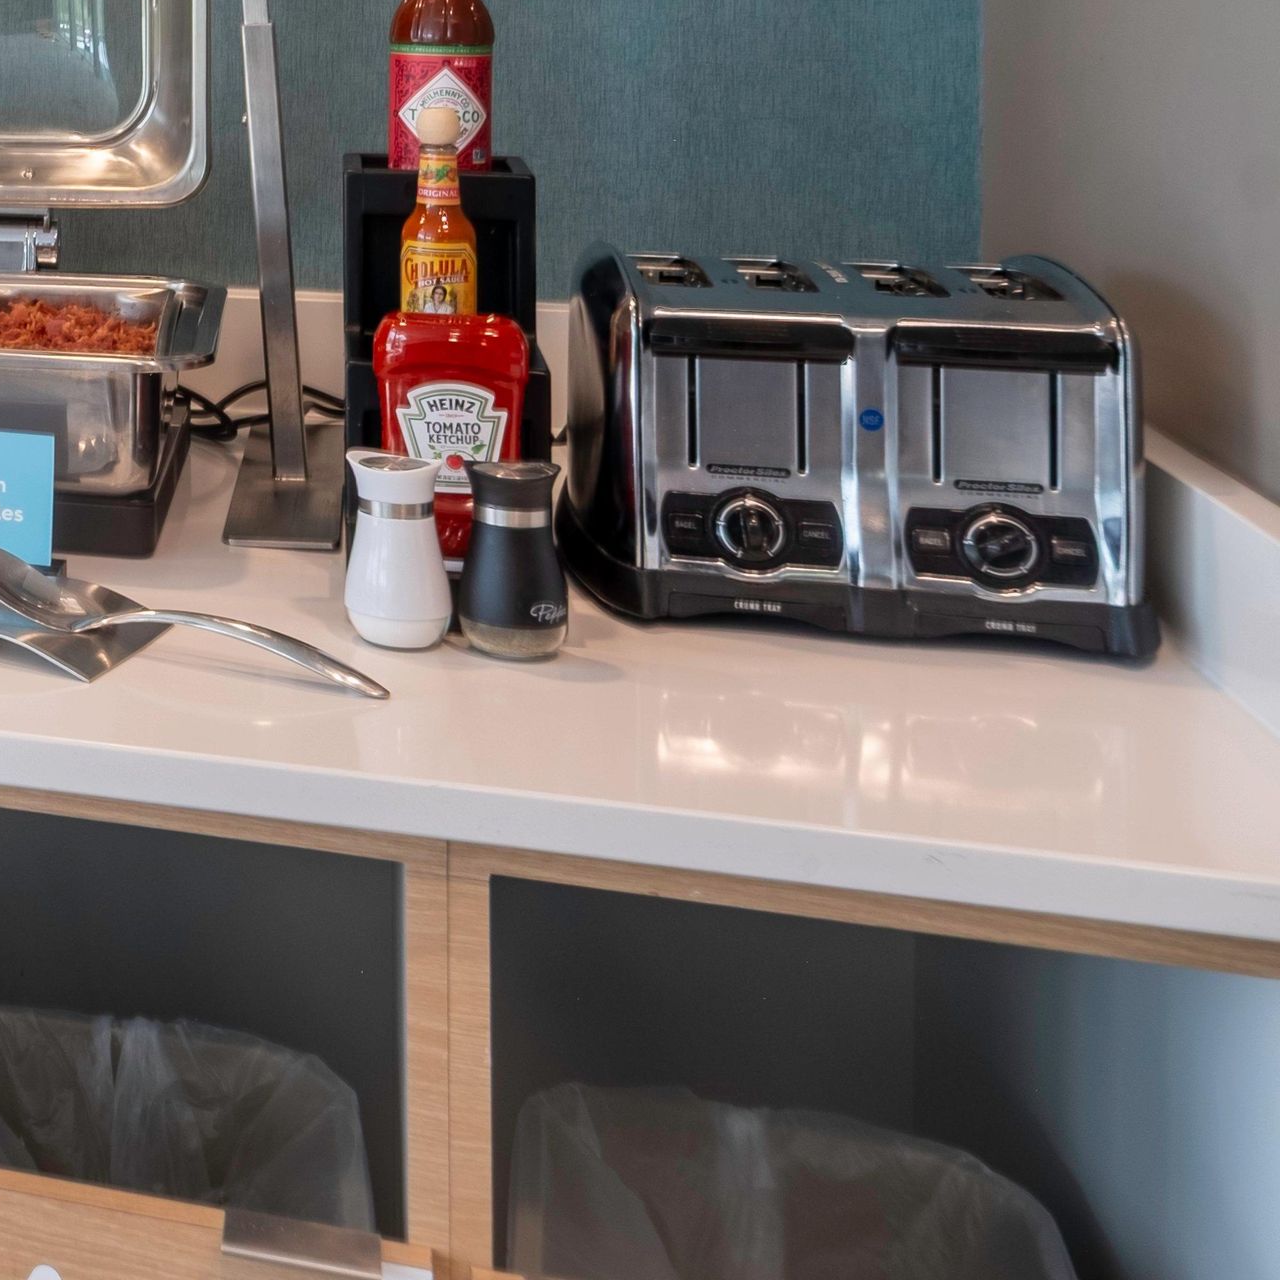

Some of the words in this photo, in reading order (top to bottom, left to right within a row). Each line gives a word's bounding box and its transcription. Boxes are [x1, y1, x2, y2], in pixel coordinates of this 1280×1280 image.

[418, 187, 458, 198] ORIGINAL
[405, 258, 471, 287] CHOLULA
[426, 398, 477, 414] HEINZ
[425, 421, 481, 435] TOMATO
[428, 434, 480, 445] KETCHUP
[711, 465, 755, 476] Proctor
[958, 482, 1005, 492] Proctor
[802, 530, 831, 540] CANCEL
